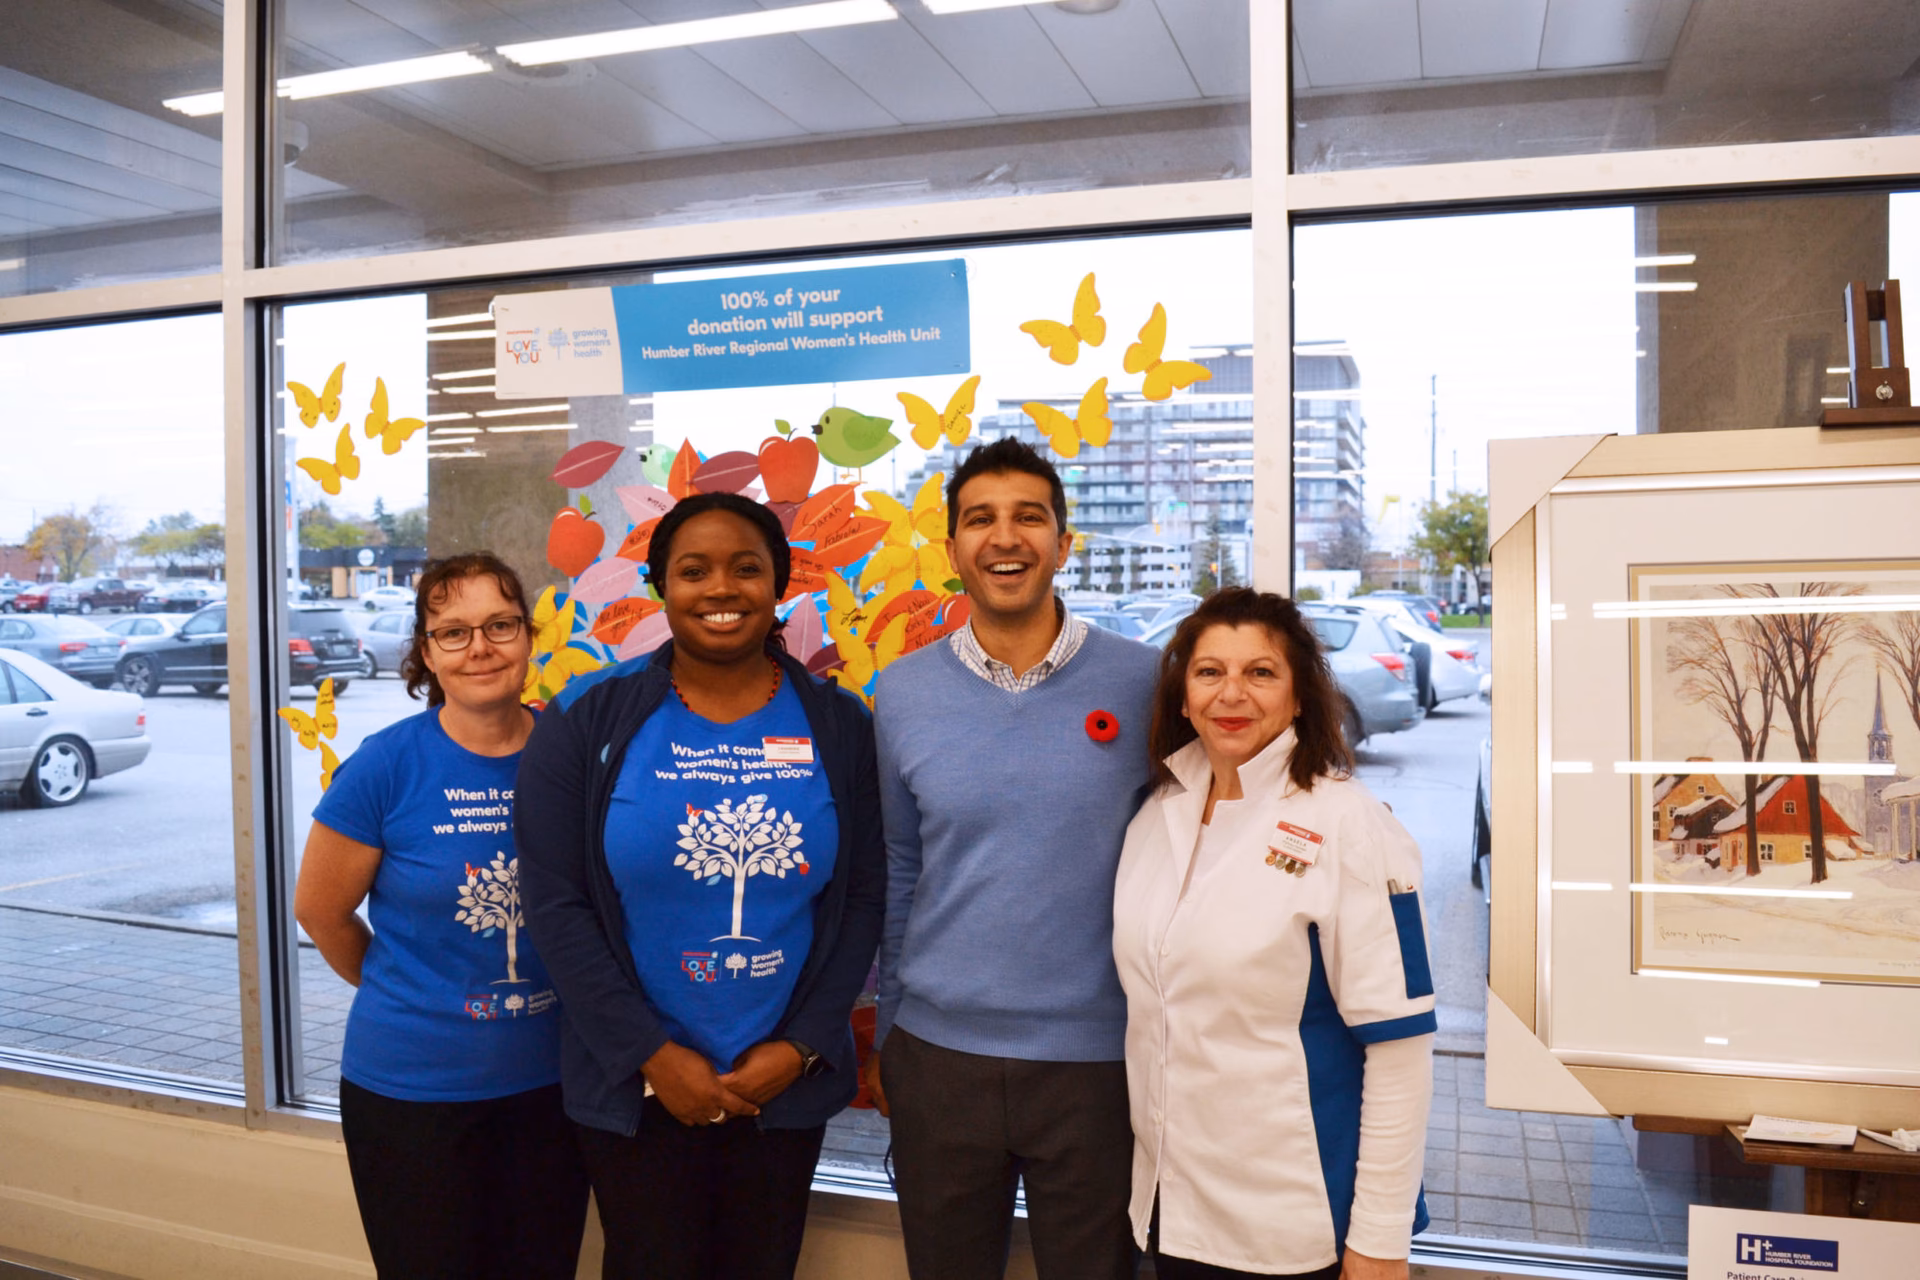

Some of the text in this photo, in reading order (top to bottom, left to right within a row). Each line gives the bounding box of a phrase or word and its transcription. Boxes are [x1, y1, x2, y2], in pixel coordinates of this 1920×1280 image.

[720, 287, 841, 310] 100% of your
[687, 306, 884, 336] donation will support
[642, 327, 941, 359] Humber River Regional Women's Health Unit
[671, 742, 714, 757] When
[718, 744, 729, 753] it
[675, 757, 739, 770] women's
[655, 769, 813, 785] we always give 100%
[444, 788, 486, 801] When
[488, 788, 499, 800] it
[450, 803, 510, 817] women's
[433, 820, 508, 834] we always
[751, 949, 783, 963] growing
[751, 957, 784, 970] women's
[750, 967, 777, 978] health
[1765, 1251, 1812, 1260] HUMBER RIVER
[1765, 1257, 1834, 1268] HOSPITAL FOUNDATION
[1727, 1271, 1761, 1280] Patient
